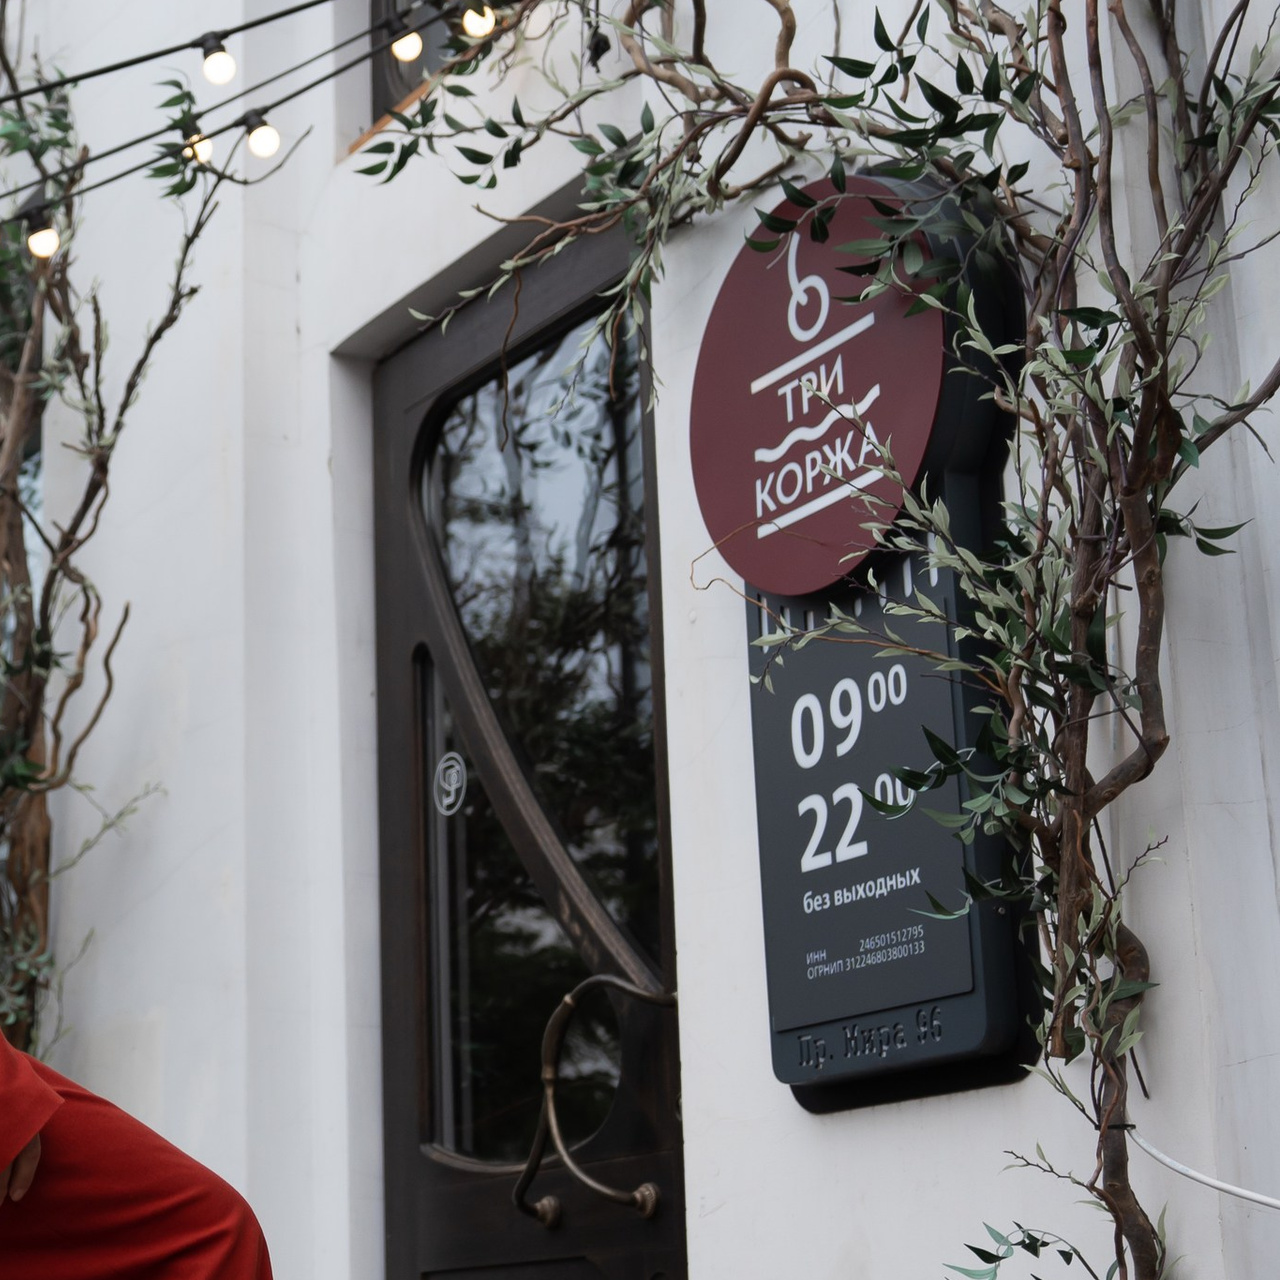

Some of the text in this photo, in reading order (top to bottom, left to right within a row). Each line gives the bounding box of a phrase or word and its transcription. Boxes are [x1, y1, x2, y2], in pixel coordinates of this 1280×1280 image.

[777, 353, 844, 423] ТРИ
[755, 420, 882, 519] КОРЖА
[803, 866, 921, 914] без выходных
[806, 923, 924, 965] ИНН 246501512795
[806, 939, 926, 980] ОГРНИП 312246803800133
[797, 1005, 943, 1071] Пр. Мира 96
